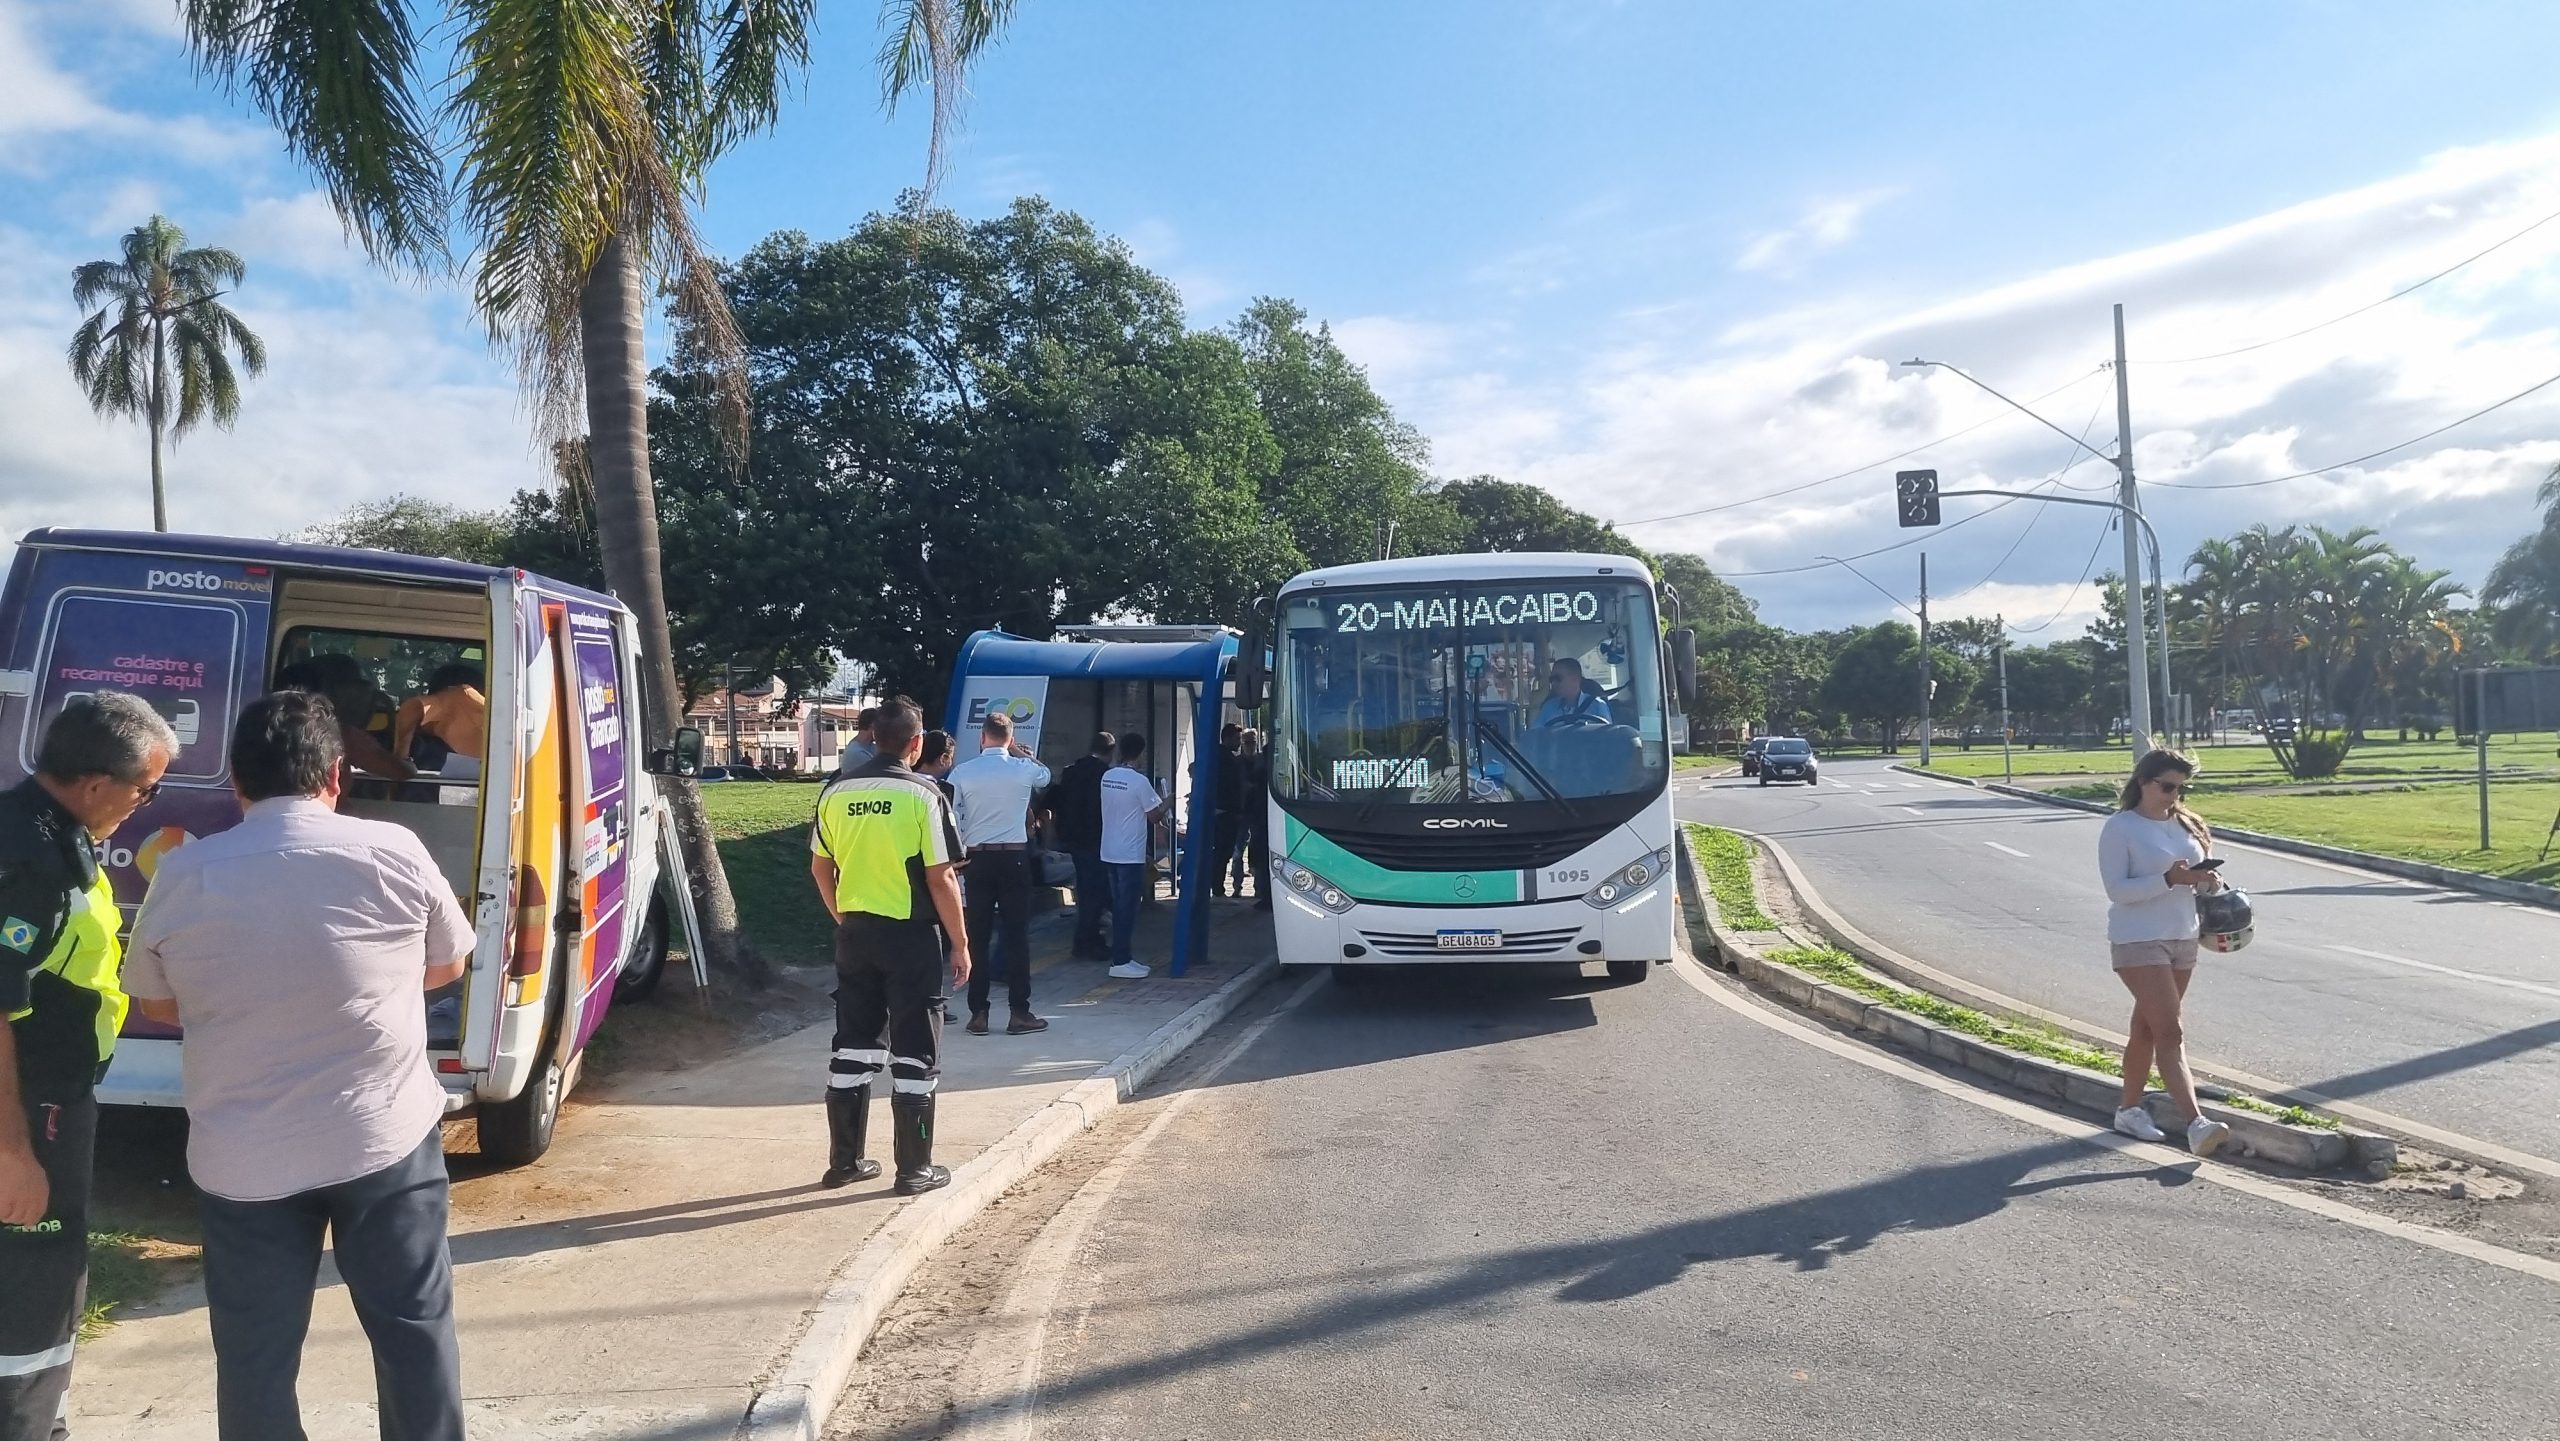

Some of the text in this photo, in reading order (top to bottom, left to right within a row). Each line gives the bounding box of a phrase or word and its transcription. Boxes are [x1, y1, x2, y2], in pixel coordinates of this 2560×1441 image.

[146, 569, 221, 591] posto
[1337, 591, 1599, 632] 20-MARACAIBO
[113, 655, 205, 673] cadastre e
[60, 667, 203, 691] recarregue aqui
[967, 698, 1035, 723] ECO
[847, 800, 893, 816] SEMOB
[1423, 818, 1508, 829] COMIL
[1548, 870, 1590, 883] 1095
